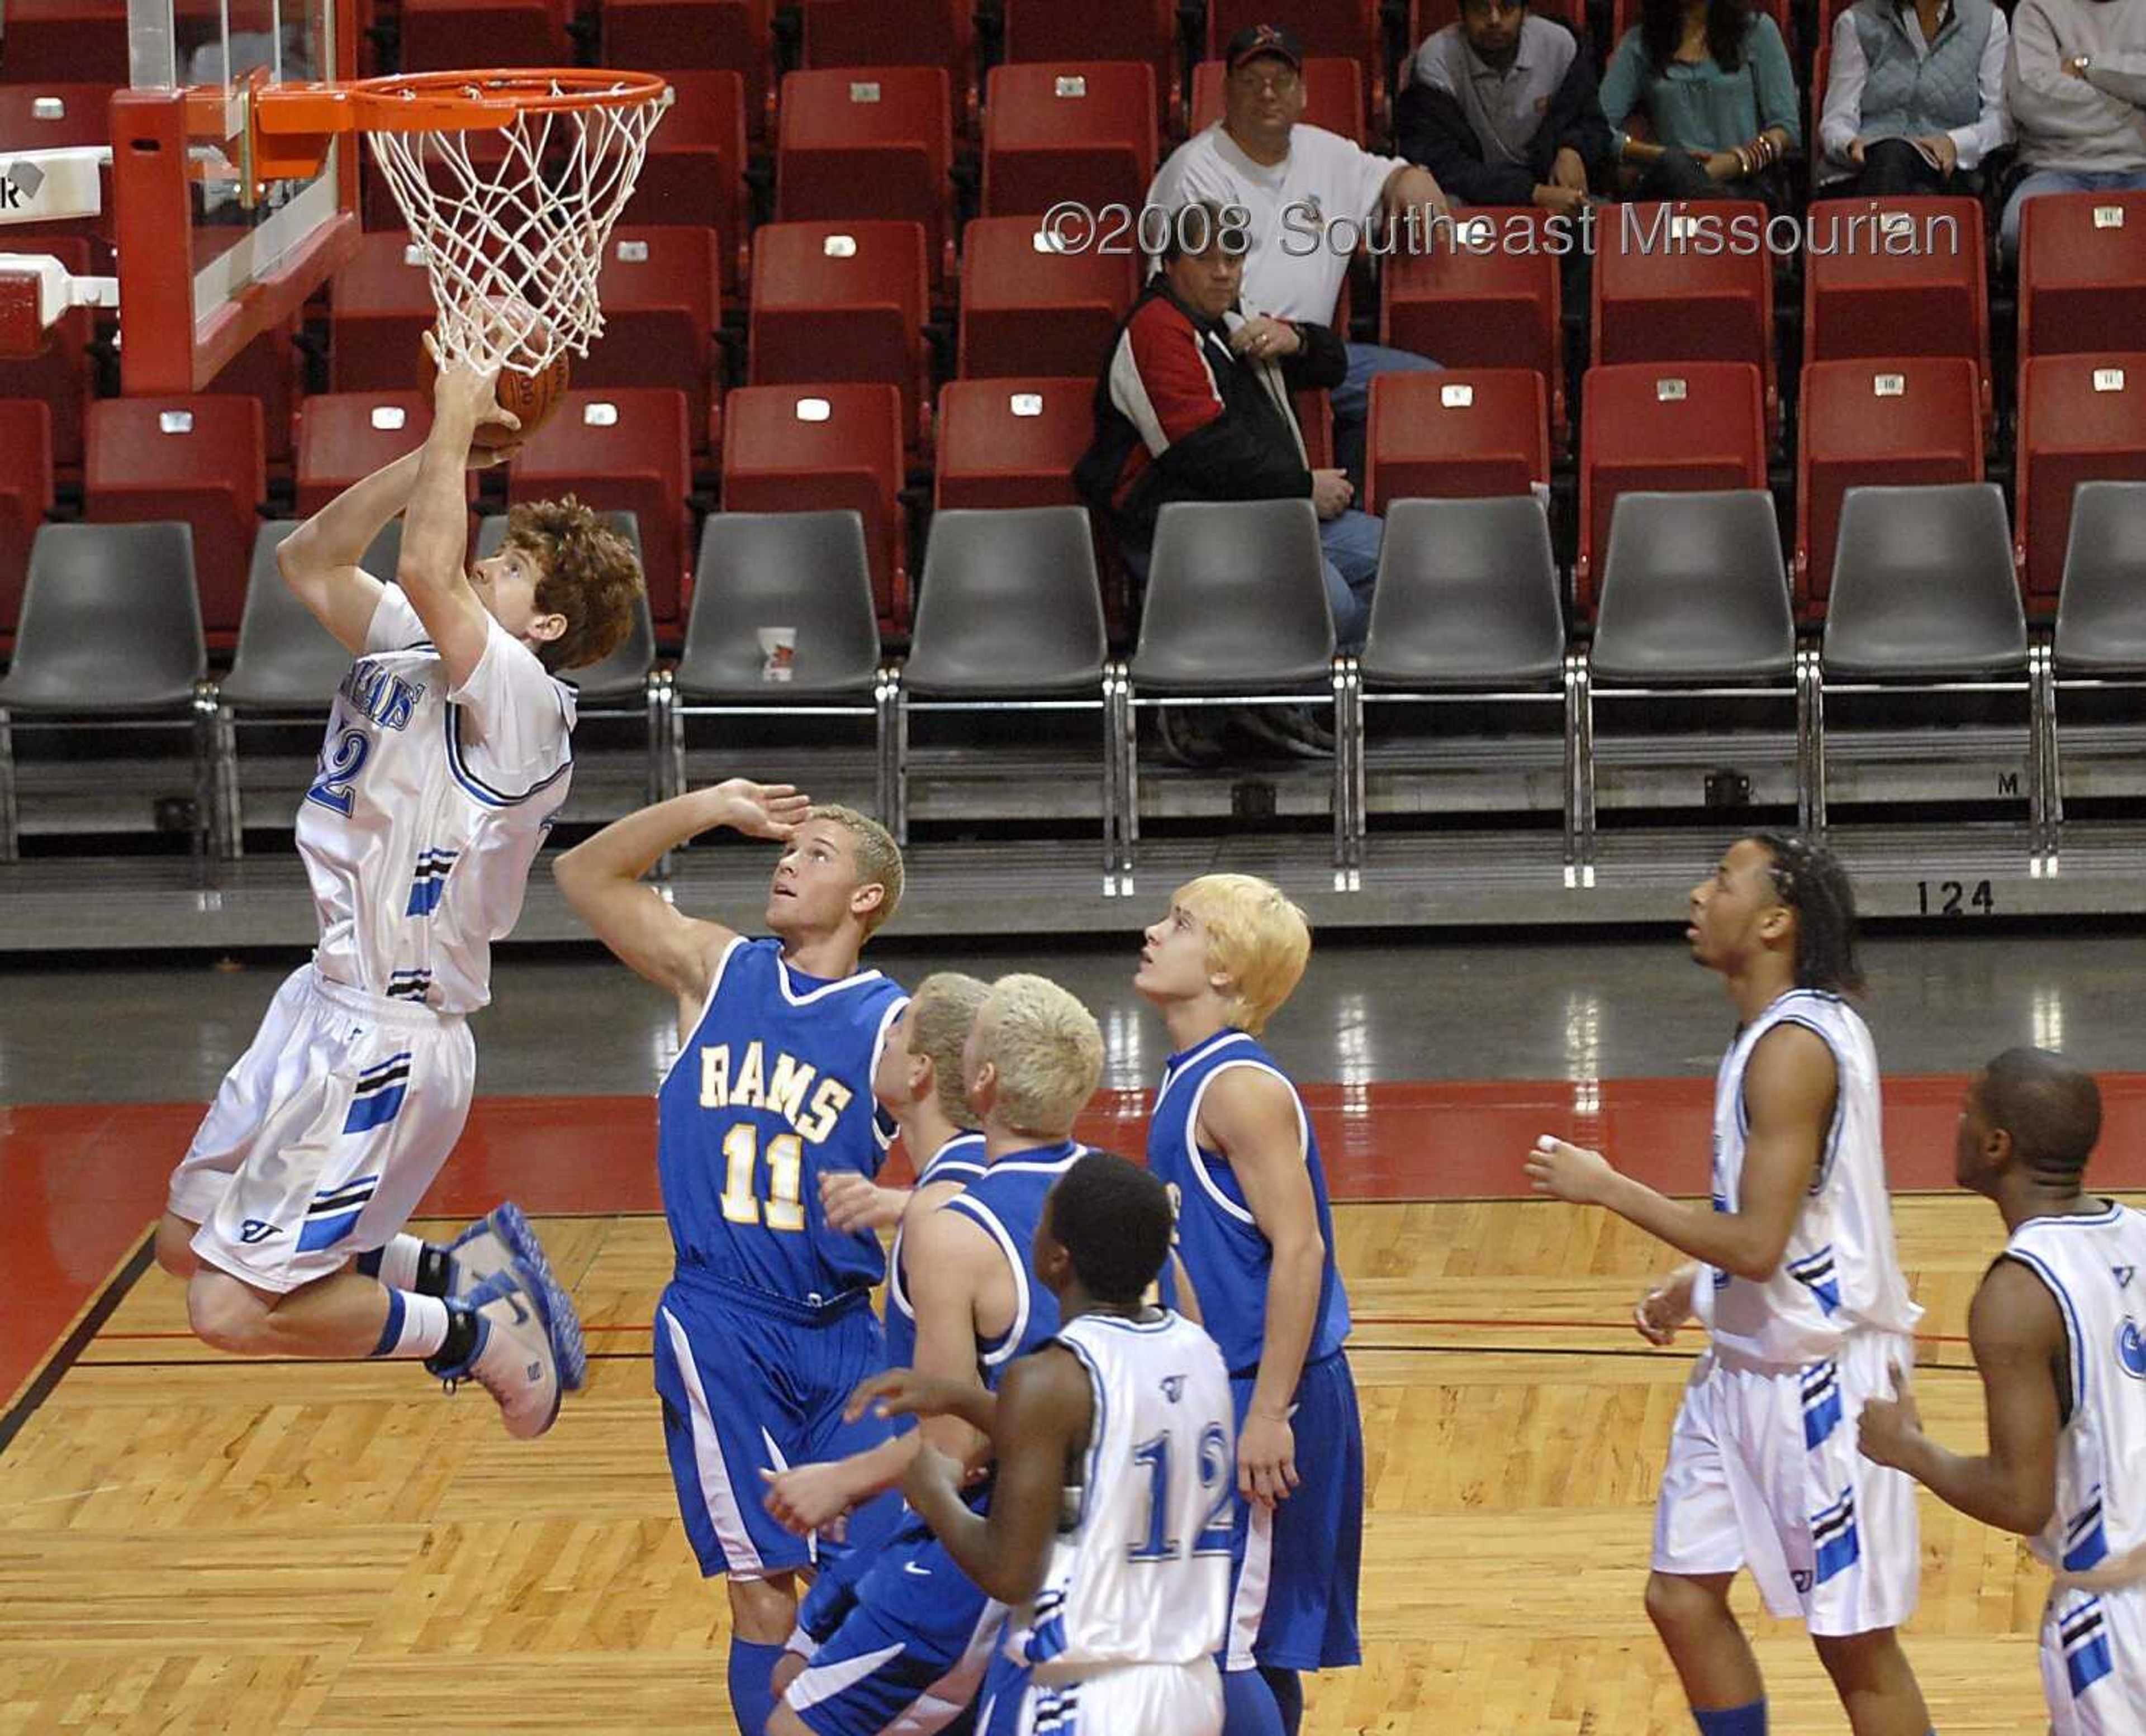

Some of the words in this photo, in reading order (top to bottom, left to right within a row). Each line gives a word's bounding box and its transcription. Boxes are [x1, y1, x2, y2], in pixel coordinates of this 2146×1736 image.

[1998, 773, 2017, 795] M
[1917, 880, 1994, 915] 124
[699, 1040, 853, 1144] RAMS
[719, 1122, 805, 1231] 11
[1126, 1421, 1233, 1562] 12
